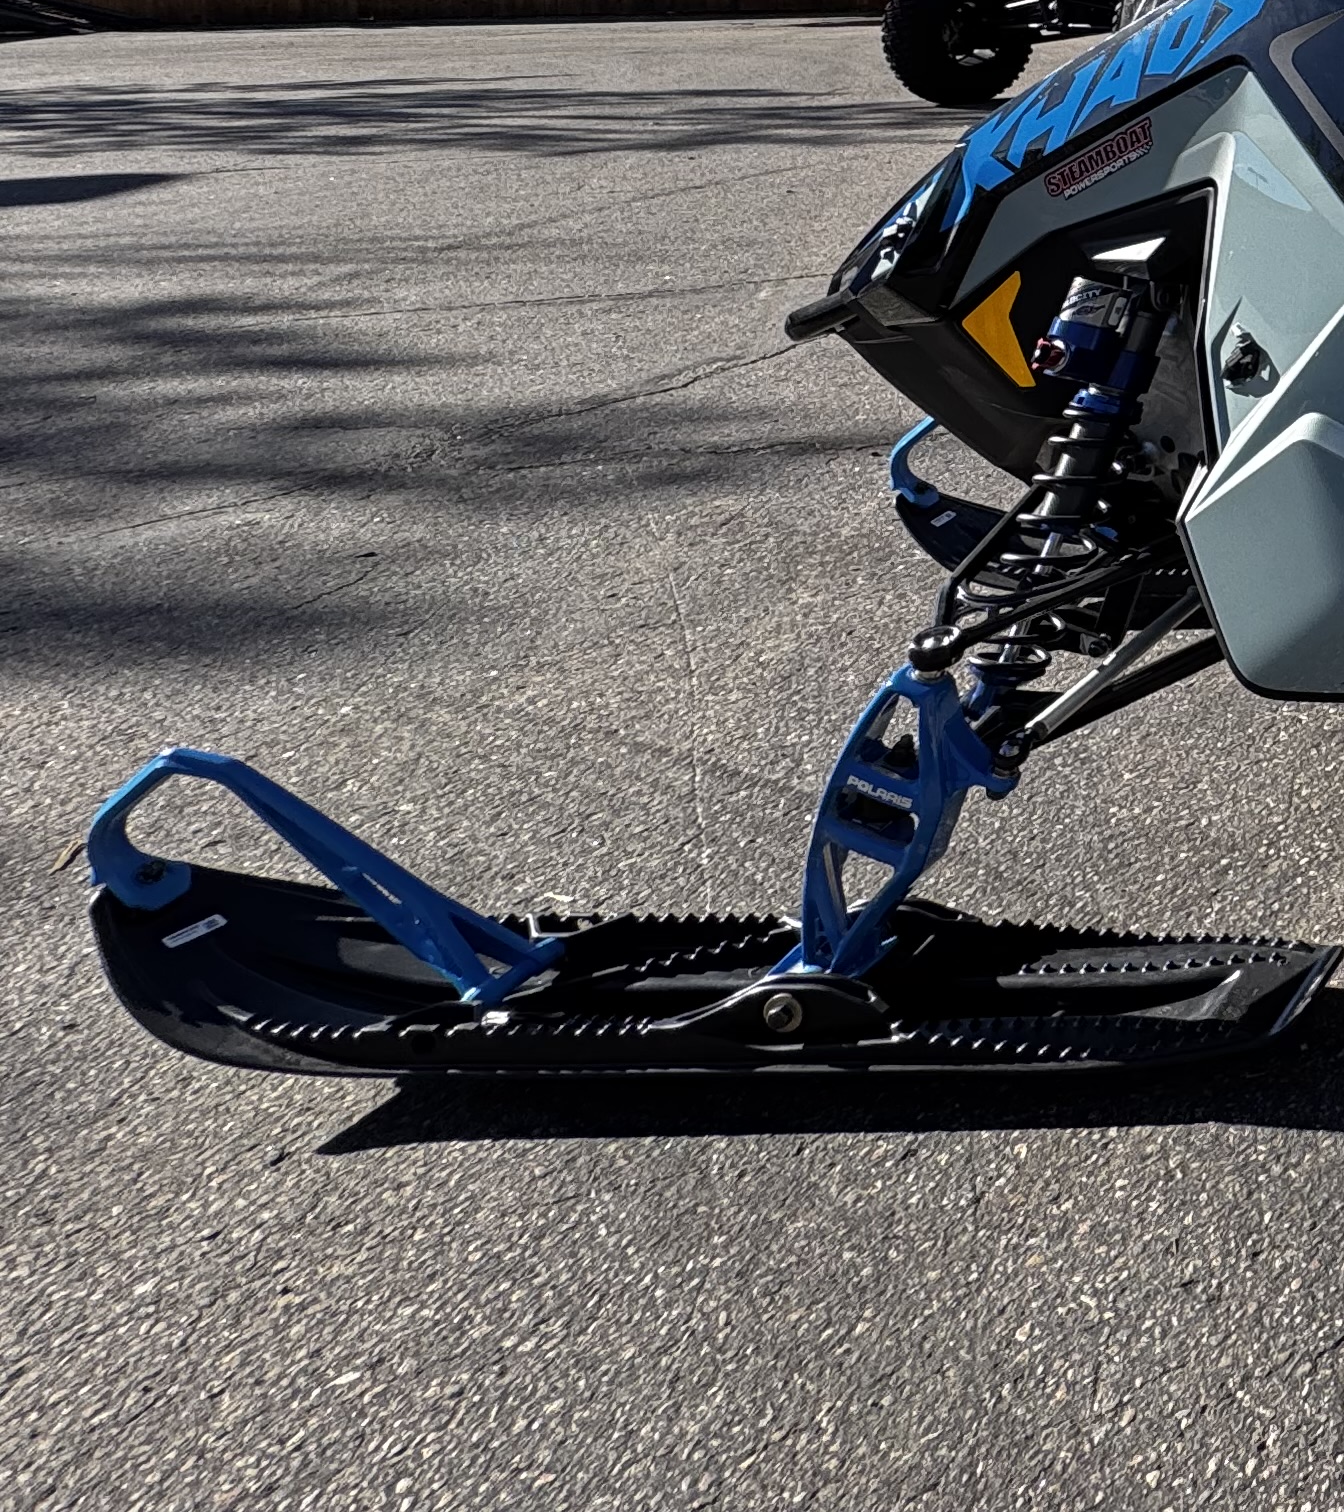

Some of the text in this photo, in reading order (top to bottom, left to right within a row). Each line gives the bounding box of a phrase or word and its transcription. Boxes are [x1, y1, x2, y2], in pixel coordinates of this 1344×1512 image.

[1046, 119, 1152, 195] STEAMBOAT
[1064, 152, 1138, 200] POWERSPORTS
[846, 774, 914, 809] POLARIS
